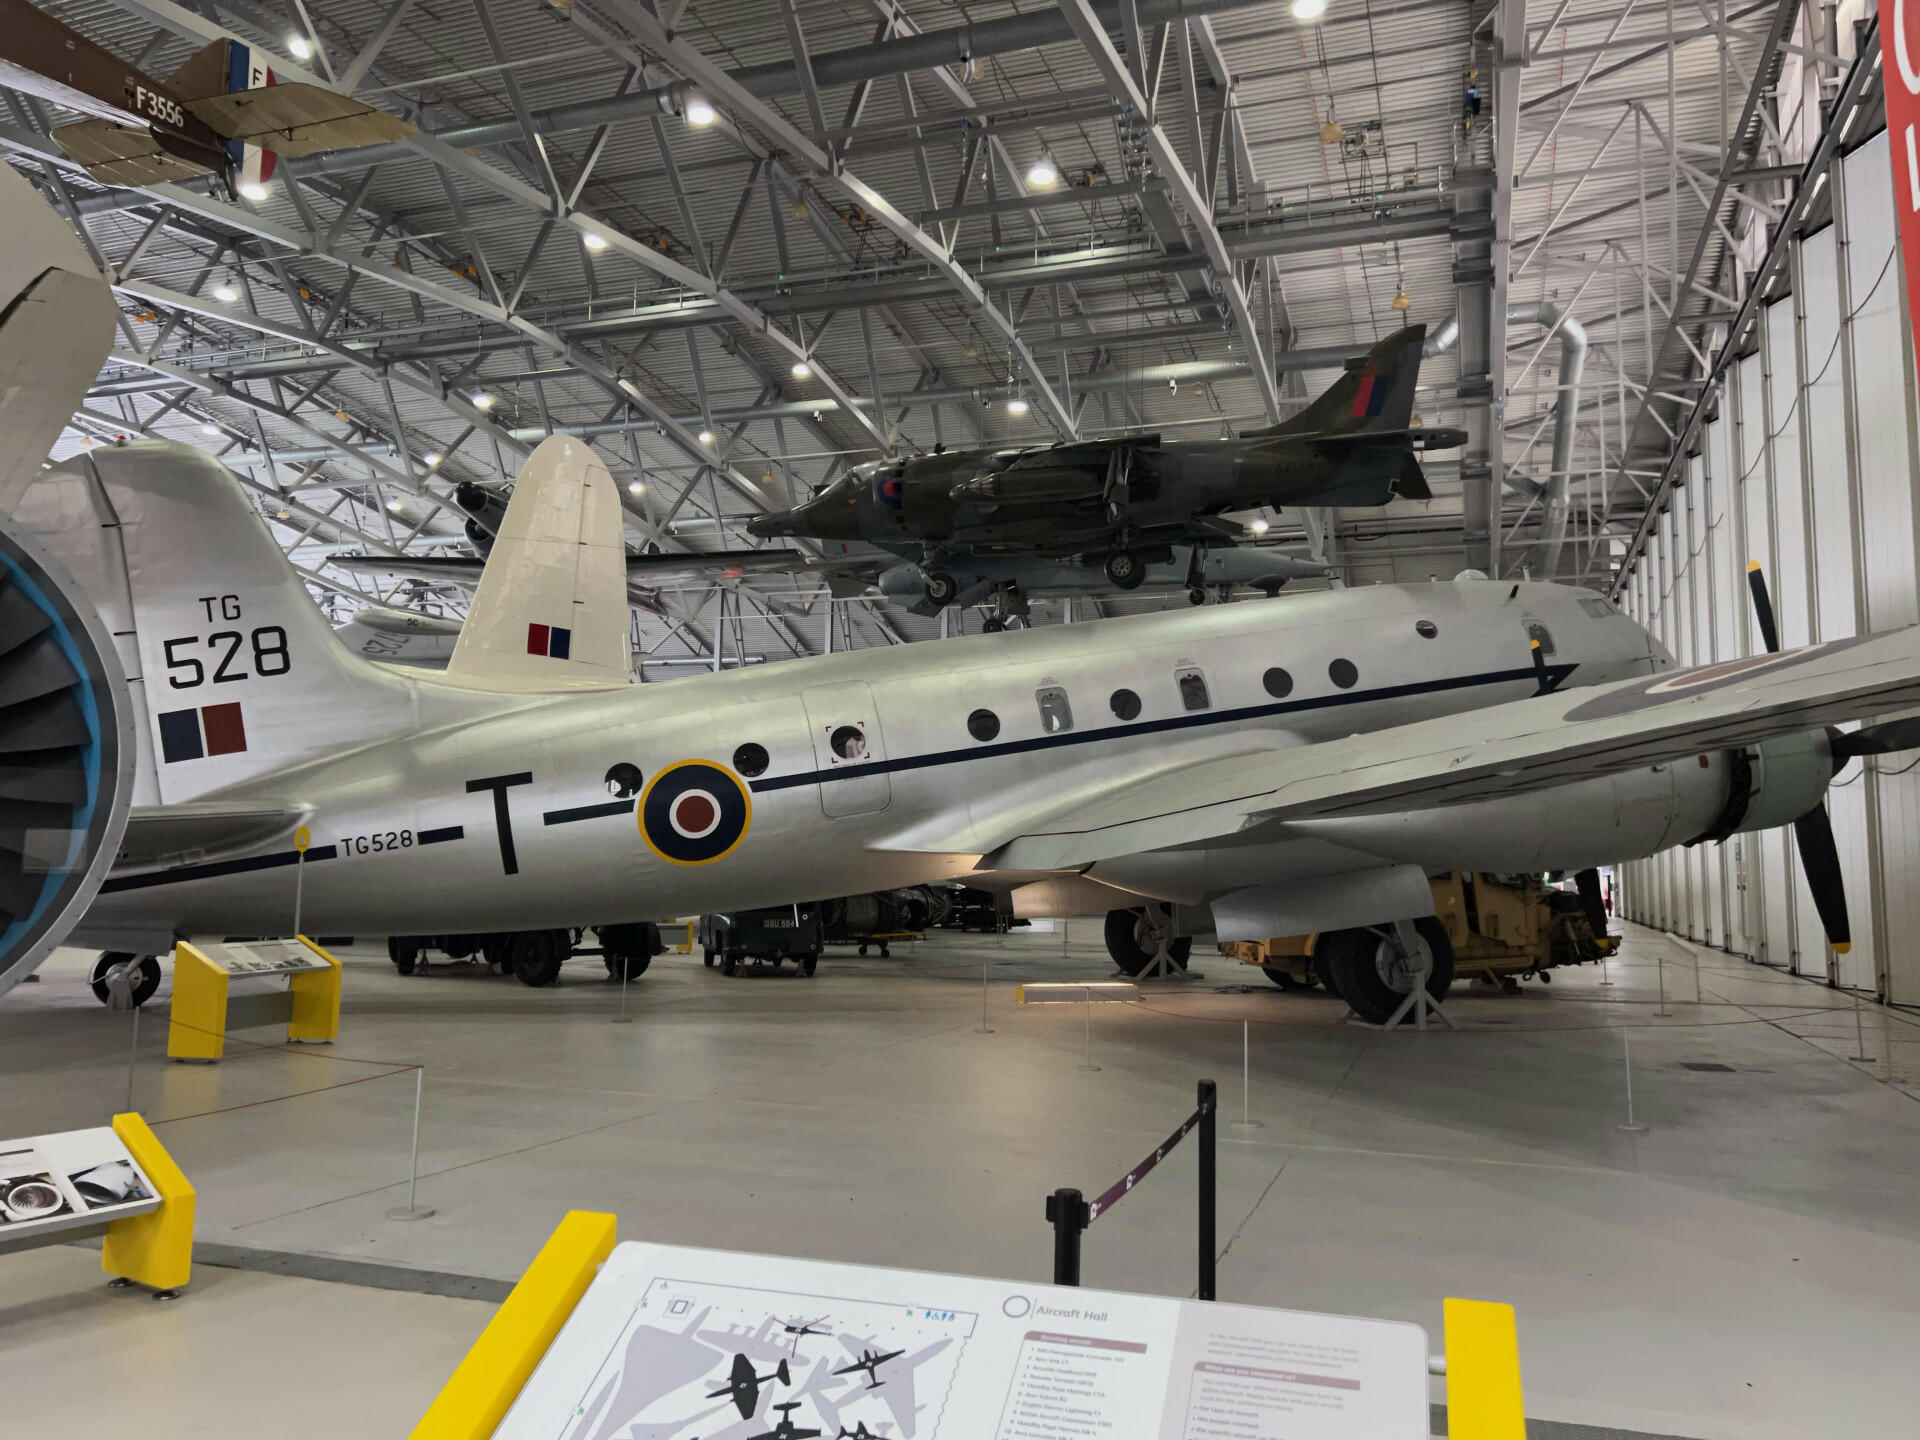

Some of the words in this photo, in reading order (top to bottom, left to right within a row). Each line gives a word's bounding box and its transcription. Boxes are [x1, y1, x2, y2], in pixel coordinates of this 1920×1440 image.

[252, 67, 263, 86] F
[136, 85, 184, 128] F3556
[198, 594, 241, 623] TG
[163, 626, 290, 689] 528
[465, 771, 533, 875] T
[341, 829, 413, 857] TG528
[1036, 1305, 1081, 1319] Aircraft
[1084, 1310, 1108, 1321] Hall
